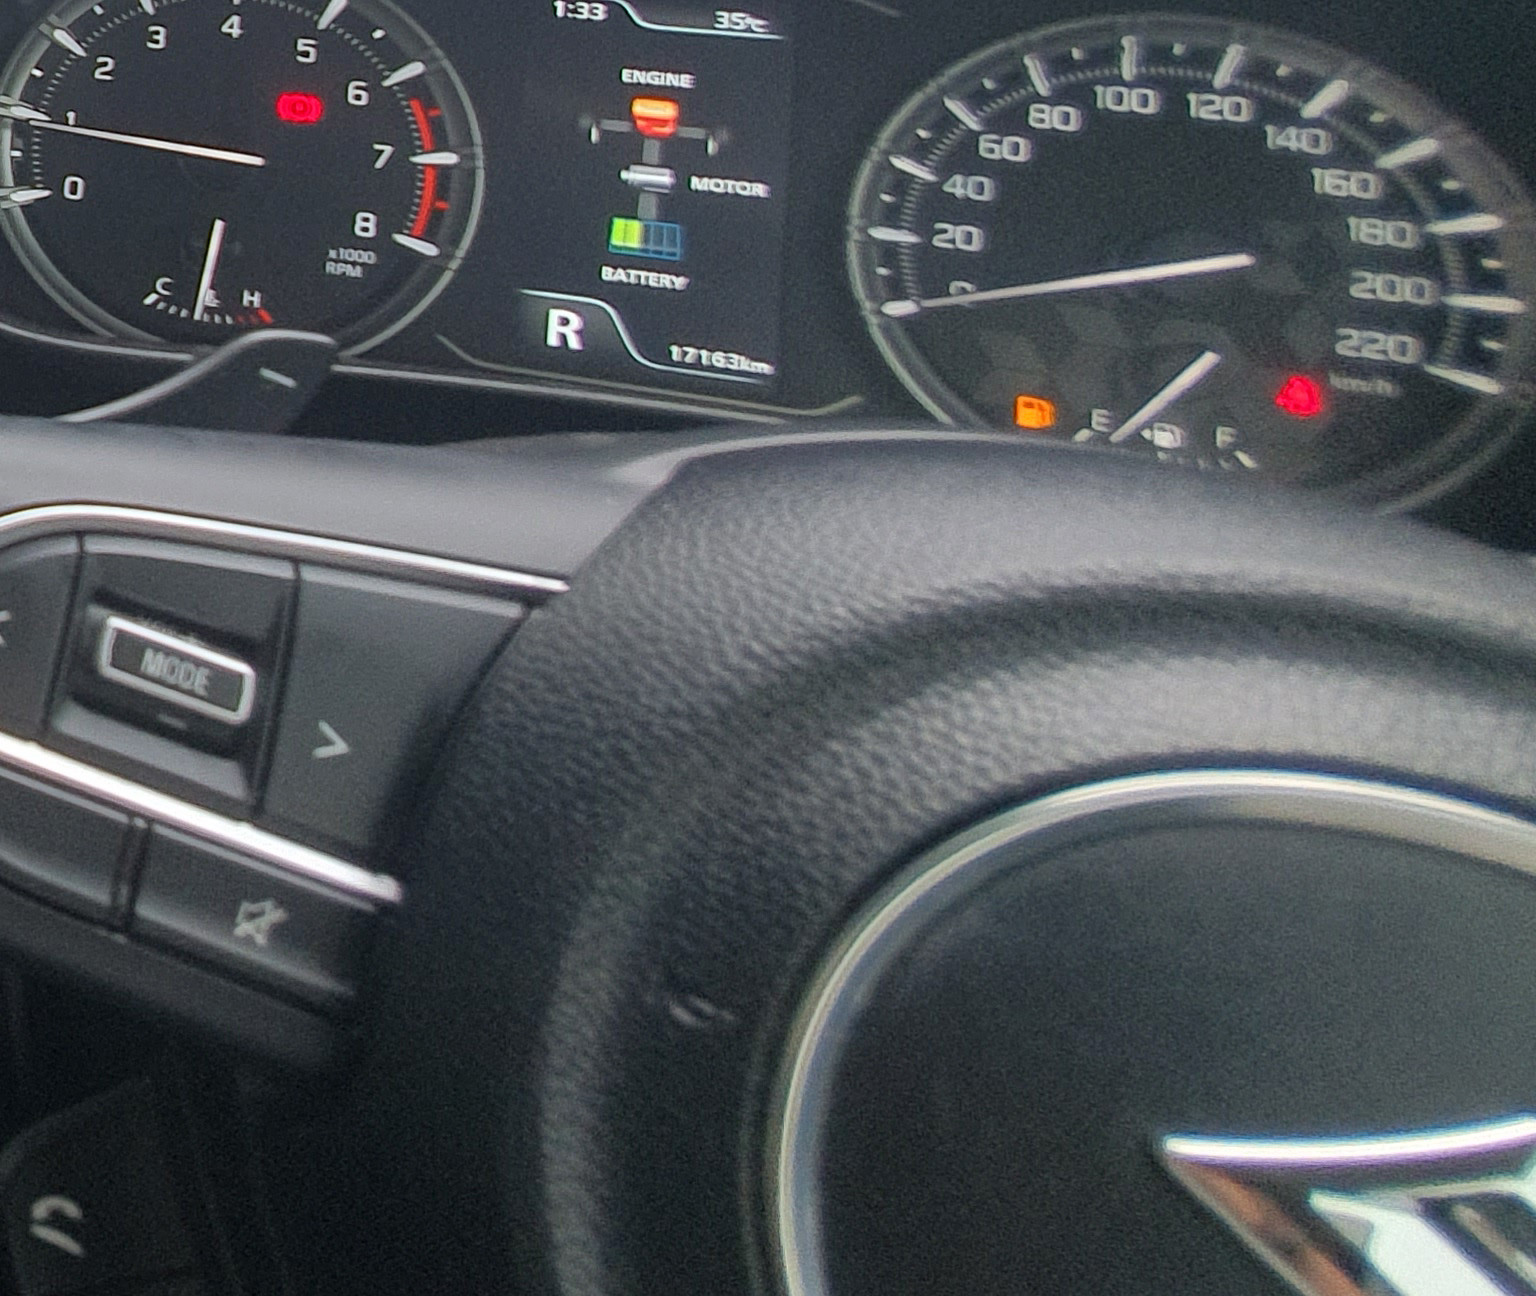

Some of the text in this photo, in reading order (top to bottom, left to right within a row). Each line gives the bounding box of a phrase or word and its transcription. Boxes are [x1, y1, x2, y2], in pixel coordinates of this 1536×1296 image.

[554, 0, 608, 21] 1:33
[146, 27, 168, 48] 3
[221, 16, 244, 38] 4
[296, 40, 318, 64] 5
[94, 57, 116, 81] 2
[621, 69, 696, 88] ENGINE
[347, 82, 370, 106] 6
[1095, 85, 1159, 115] 100
[1028, 104, 1082, 133] 80
[1187, 92, 1252, 122] 120
[978, 134, 1031, 163] 60
[1265, 125, 1330, 156] 140
[373, 144, 394, 168] 7
[63, 177, 85, 200] 0
[690, 175, 771, 198] MOTOR
[942, 174, 995, 202] 40
[1312, 168, 1381, 199] 160
[354, 213, 377, 238] 8
[1348, 218, 1418, 249] 180
[932, 223, 985, 253] 20
[326, 261, 363, 277] RPM
[601, 266, 689, 290] BATTERY
[155, 277, 174, 296] C
[1349, 271, 1434, 305] 200
[243, 291, 262, 308] H
[546, 309, 584, 350] R
[1336, 328, 1424, 364] 220
[1091, 409, 1113, 432] E
[140, 648, 210, 696] MODE
